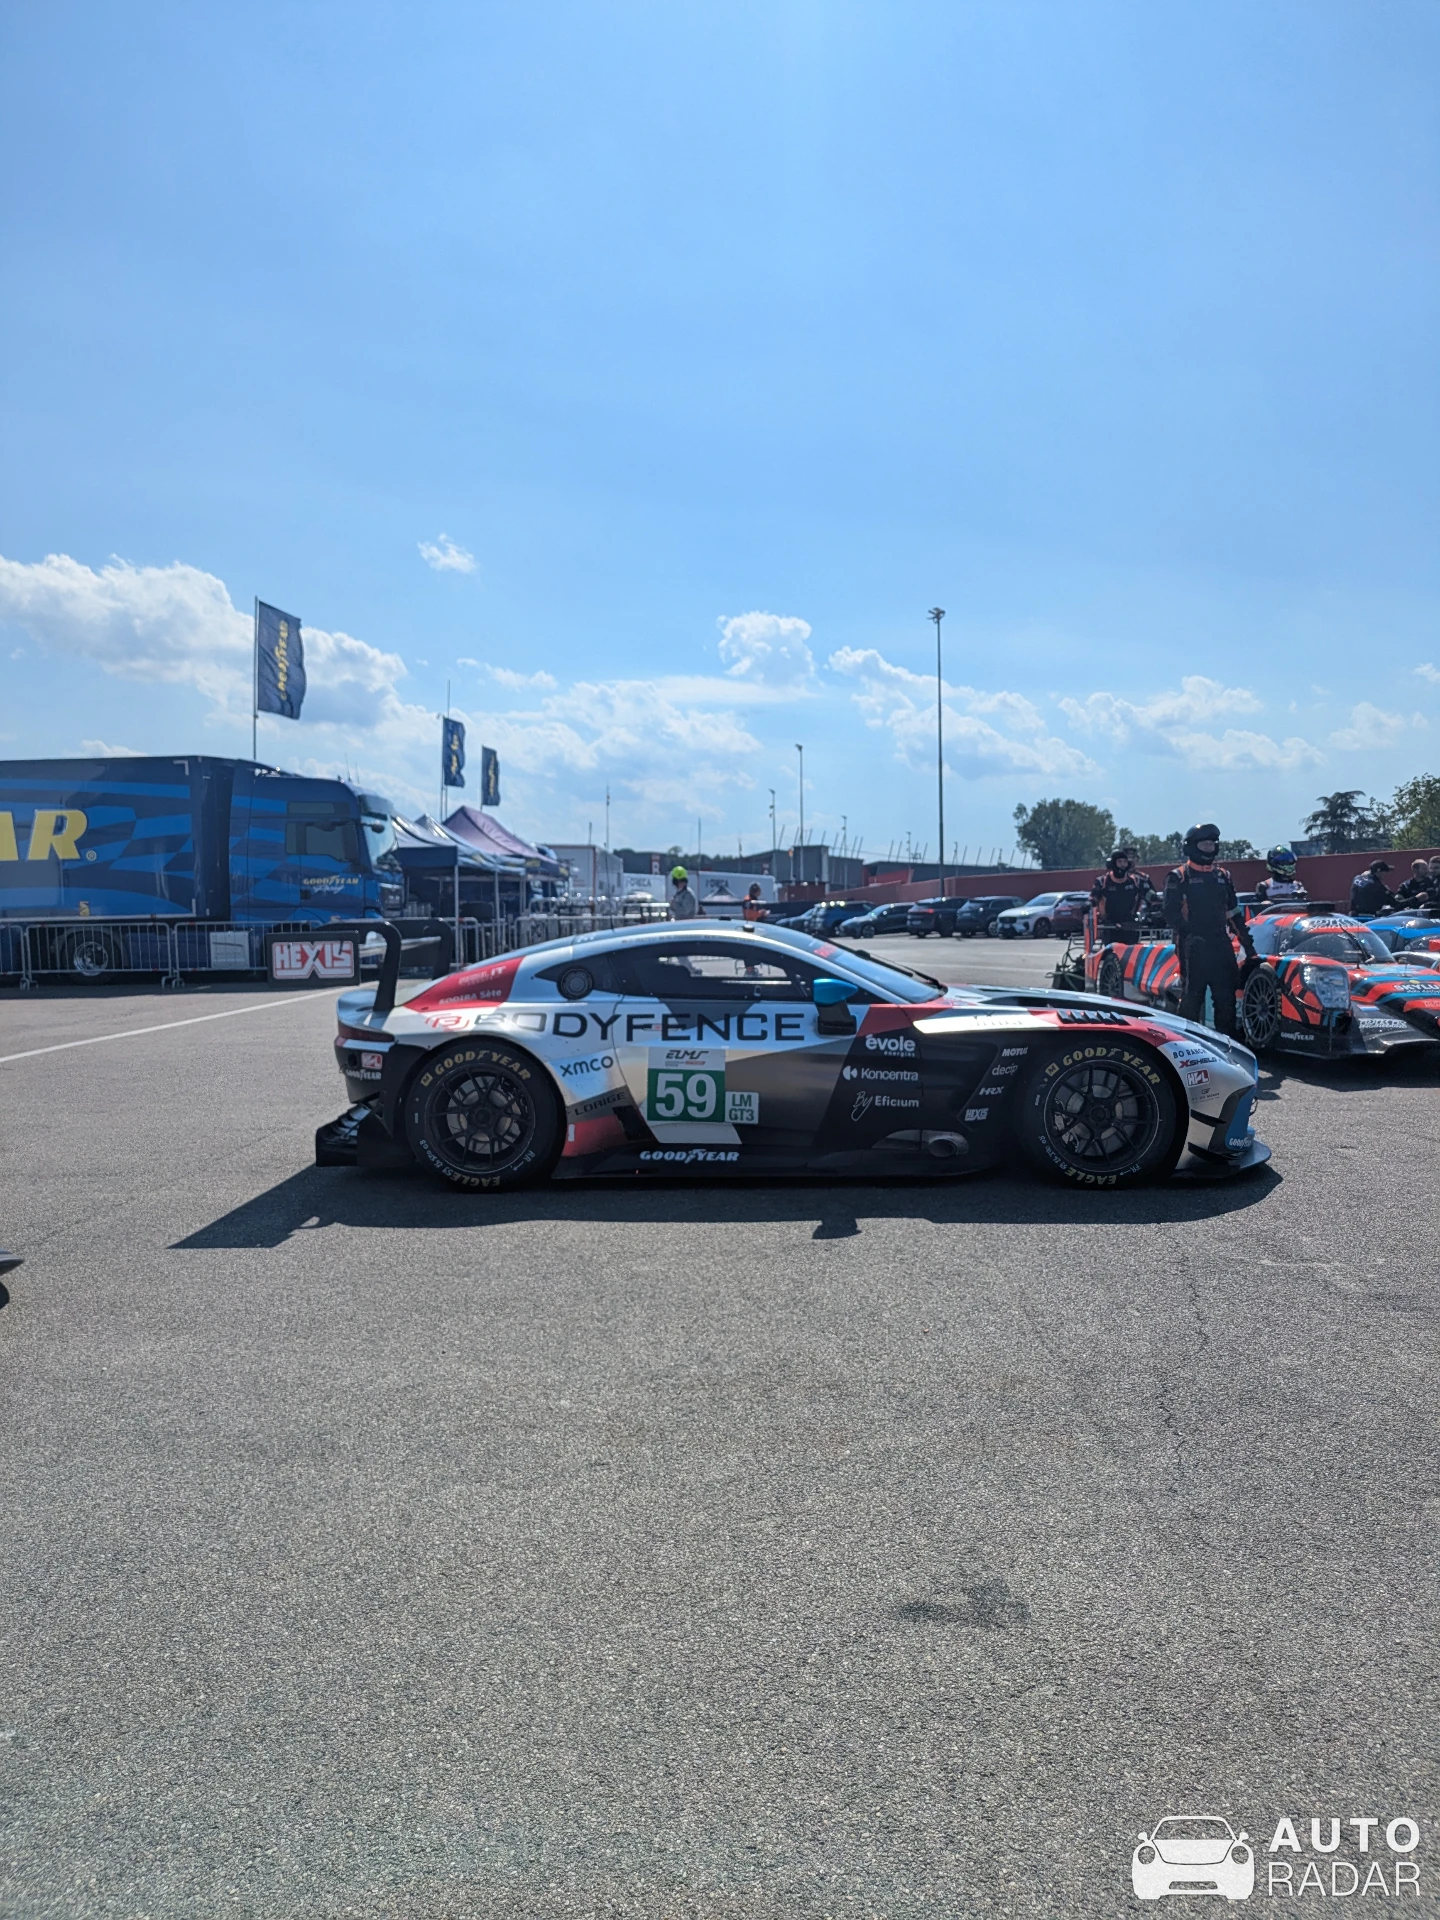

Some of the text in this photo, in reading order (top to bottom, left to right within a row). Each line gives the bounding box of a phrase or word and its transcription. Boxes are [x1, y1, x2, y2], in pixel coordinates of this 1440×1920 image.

[303, 875, 359, 886] GOODYEAR
[275, 943, 352, 976] HEXIS
[474, 1012, 804, 1042] BODYFENCE
[865, 1034, 916, 1052] évole
[1172, 1050, 1185, 1059] BO
[1179, 1057, 1217, 1069] XSHIELD
[434, 1050, 532, 1080] GOODYEAR
[560, 1056, 614, 1077] xmco
[1062, 1047, 1161, 1085] GOODYEAR
[861, 1067, 919, 1082] Koncentra
[574, 1091, 627, 1116] LORIGE
[655, 1073, 717, 1118] 59
[732, 1094, 752, 1107] LM
[729, 1108, 754, 1122] GT3
[964, 1107, 989, 1121] HEXIS
[639, 1149, 739, 1164] GOODYEAR
[450, 1171, 502, 1187] EAGLE
[1064, 1167, 1118, 1185] EAGLE
